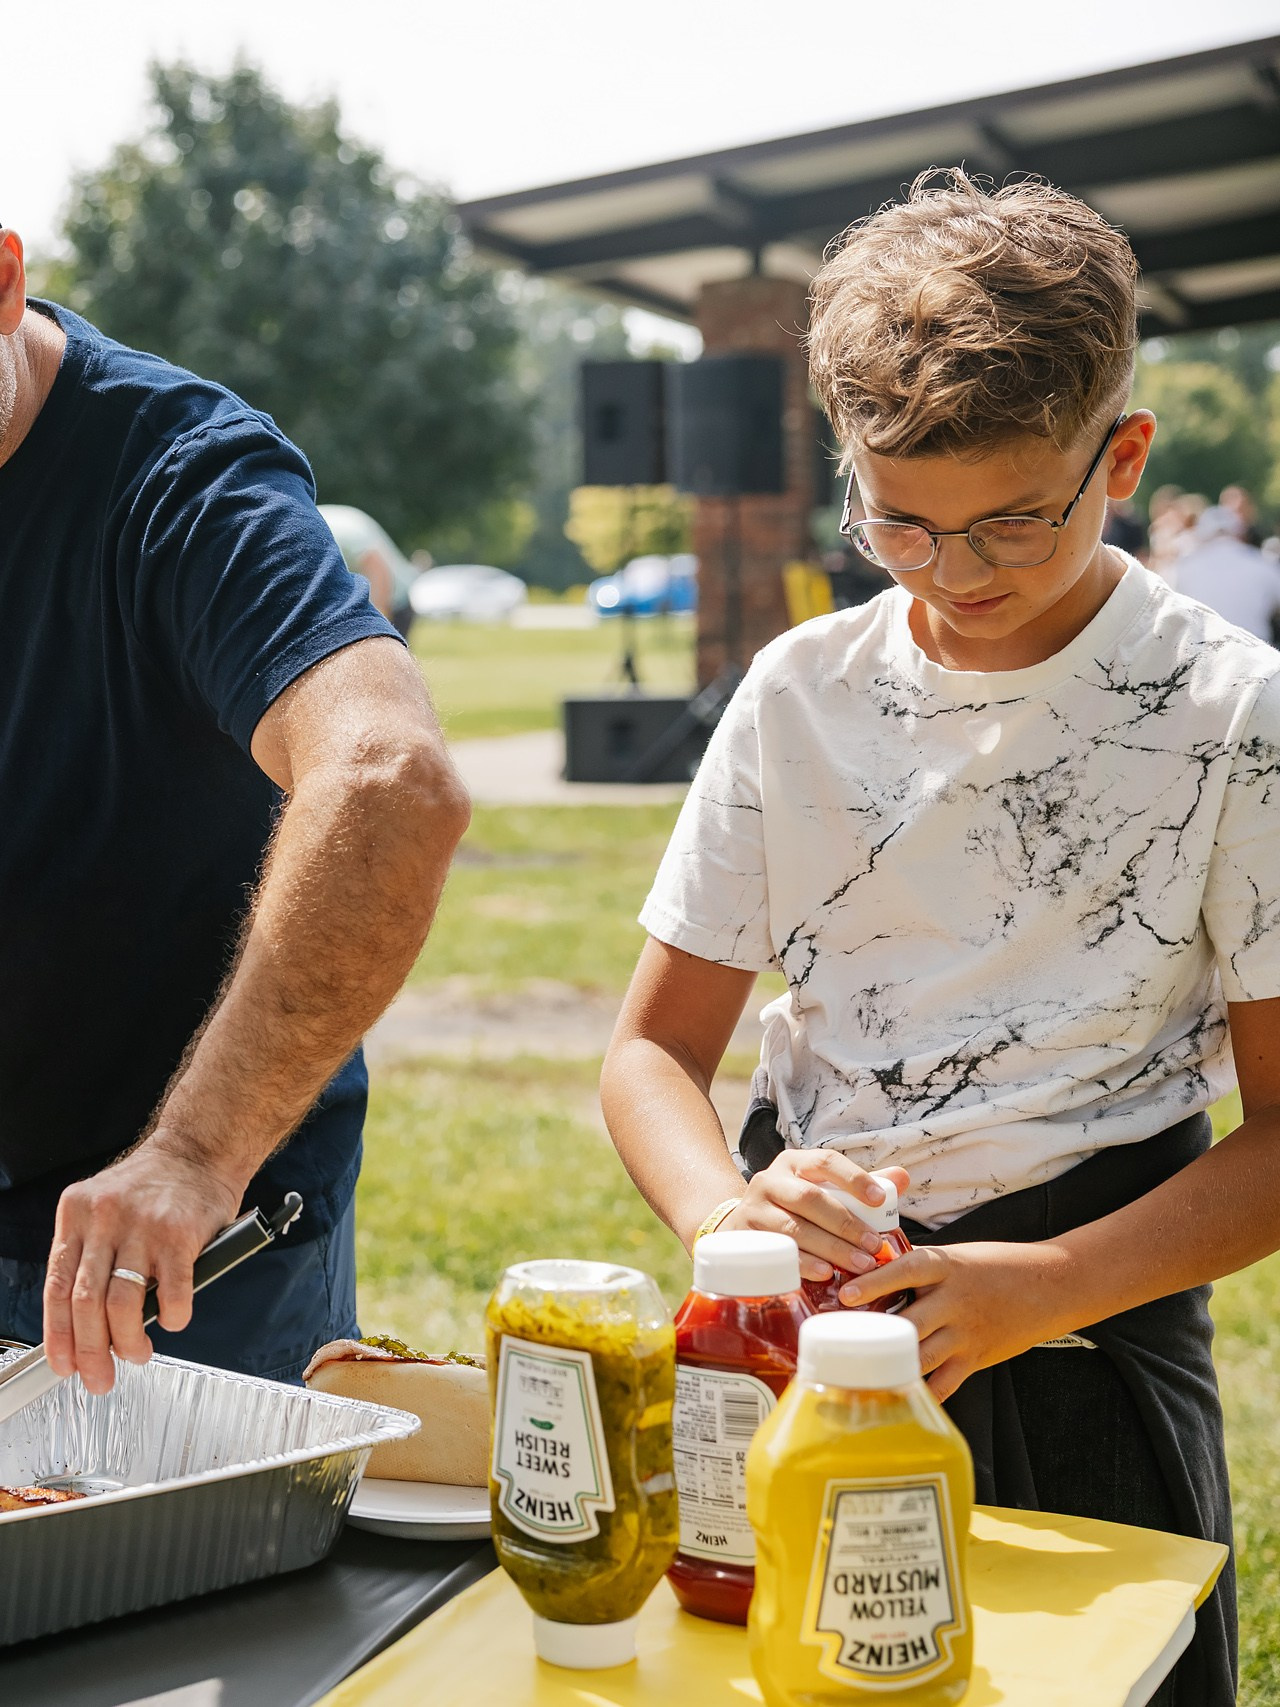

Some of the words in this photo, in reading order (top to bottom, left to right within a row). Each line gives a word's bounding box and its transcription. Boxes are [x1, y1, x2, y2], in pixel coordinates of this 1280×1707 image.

[515, 1430, 570, 1459] RELISH
[516, 1450, 570, 1478] SWEET
[514, 1488, 574, 1522] HEINZ
[695, 1530, 728, 1546] HEINZ
[834, 1566, 940, 1596] MUSTARD
[850, 1594, 927, 1621] YELLOW
[848, 1636, 929, 1667] HEINZ
